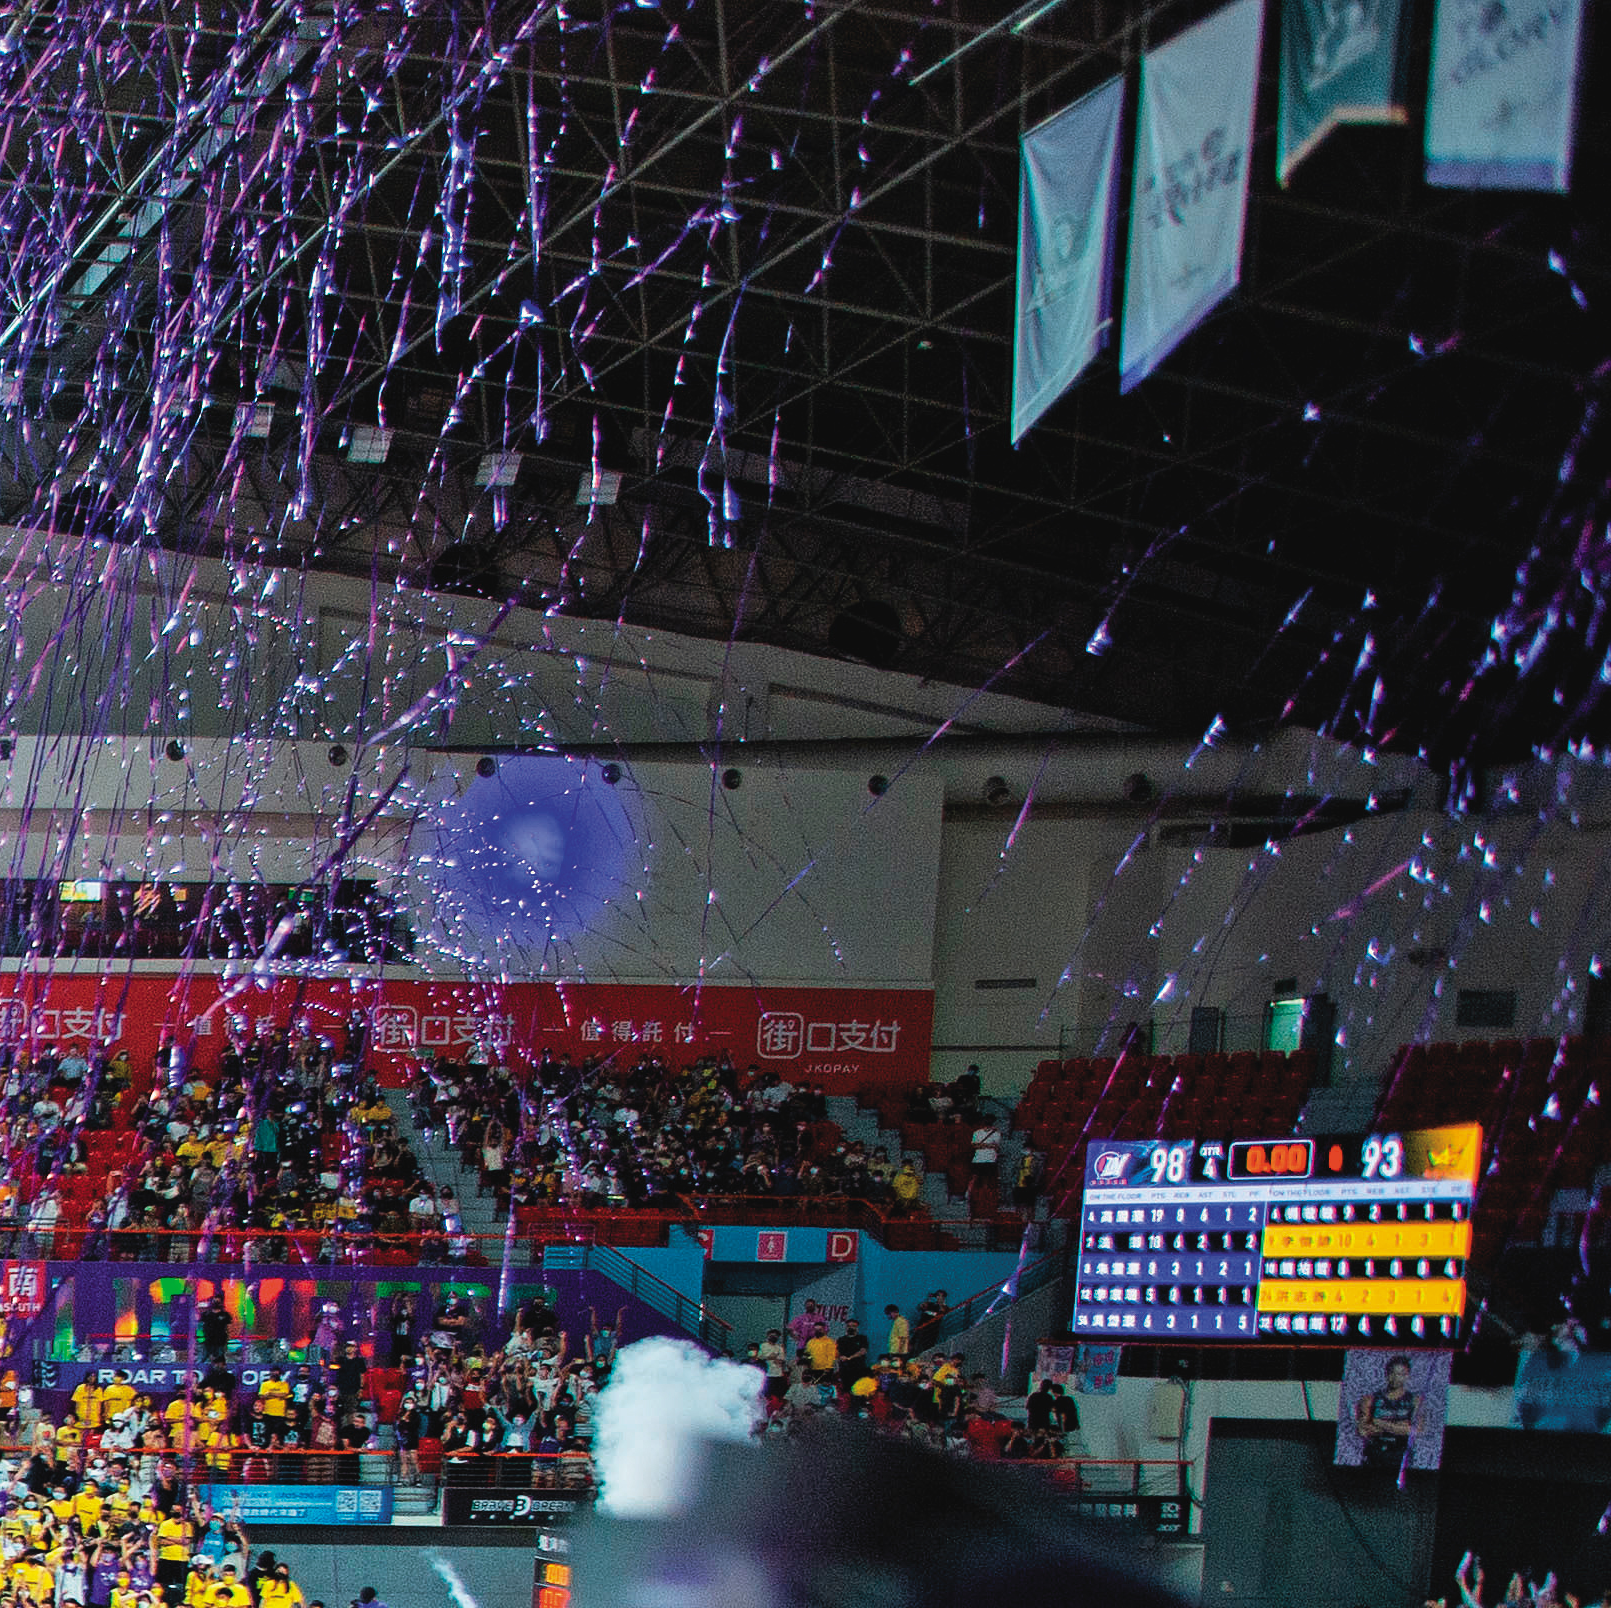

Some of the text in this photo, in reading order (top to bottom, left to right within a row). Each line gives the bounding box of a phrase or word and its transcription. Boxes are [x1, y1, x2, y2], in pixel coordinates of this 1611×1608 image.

[763, 1019, 901, 1053] 街口支付
[805, 1064, 860, 1074] JKOPAY
[1150, 1147, 1187, 1183] 98
[1362, 1141, 1402, 1179] 93
[831, 1234, 853, 1257] D
[3, 1302, 41, 1312] SOUTH
